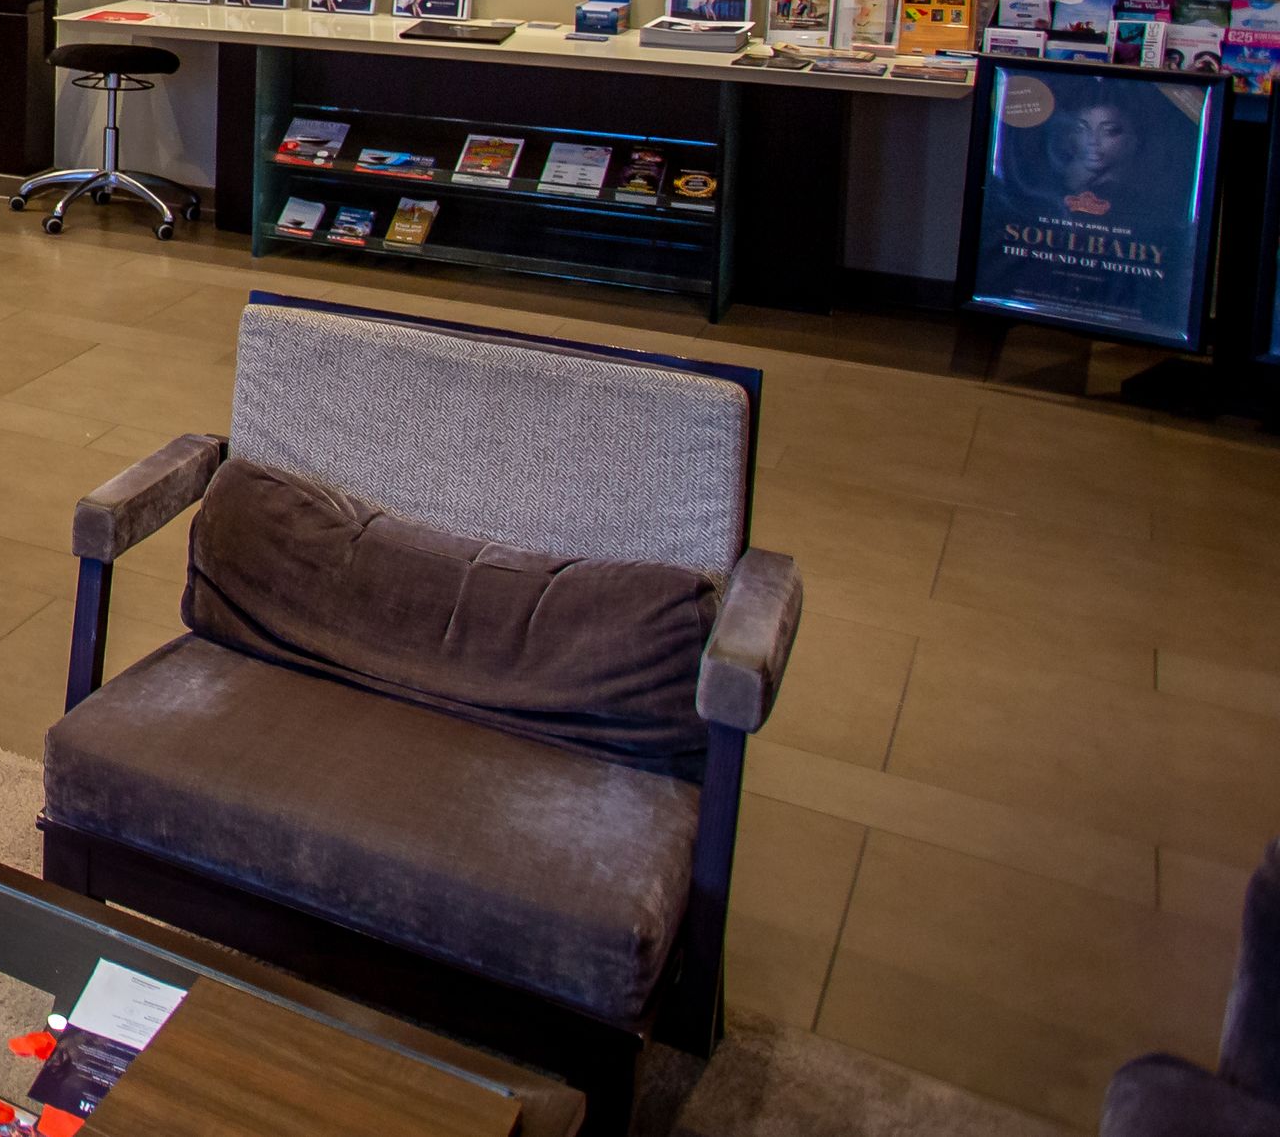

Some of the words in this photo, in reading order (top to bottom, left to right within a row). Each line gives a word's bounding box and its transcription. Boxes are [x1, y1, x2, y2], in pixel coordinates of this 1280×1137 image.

[1002, 245, 1028, 257] THE
[1031, 249, 1077, 265] SOUND
[1079, 257, 1098, 268] OF
[1101, 260, 1165, 280] MOTOWN
[1005, 223, 1167, 265] SOULBABY
